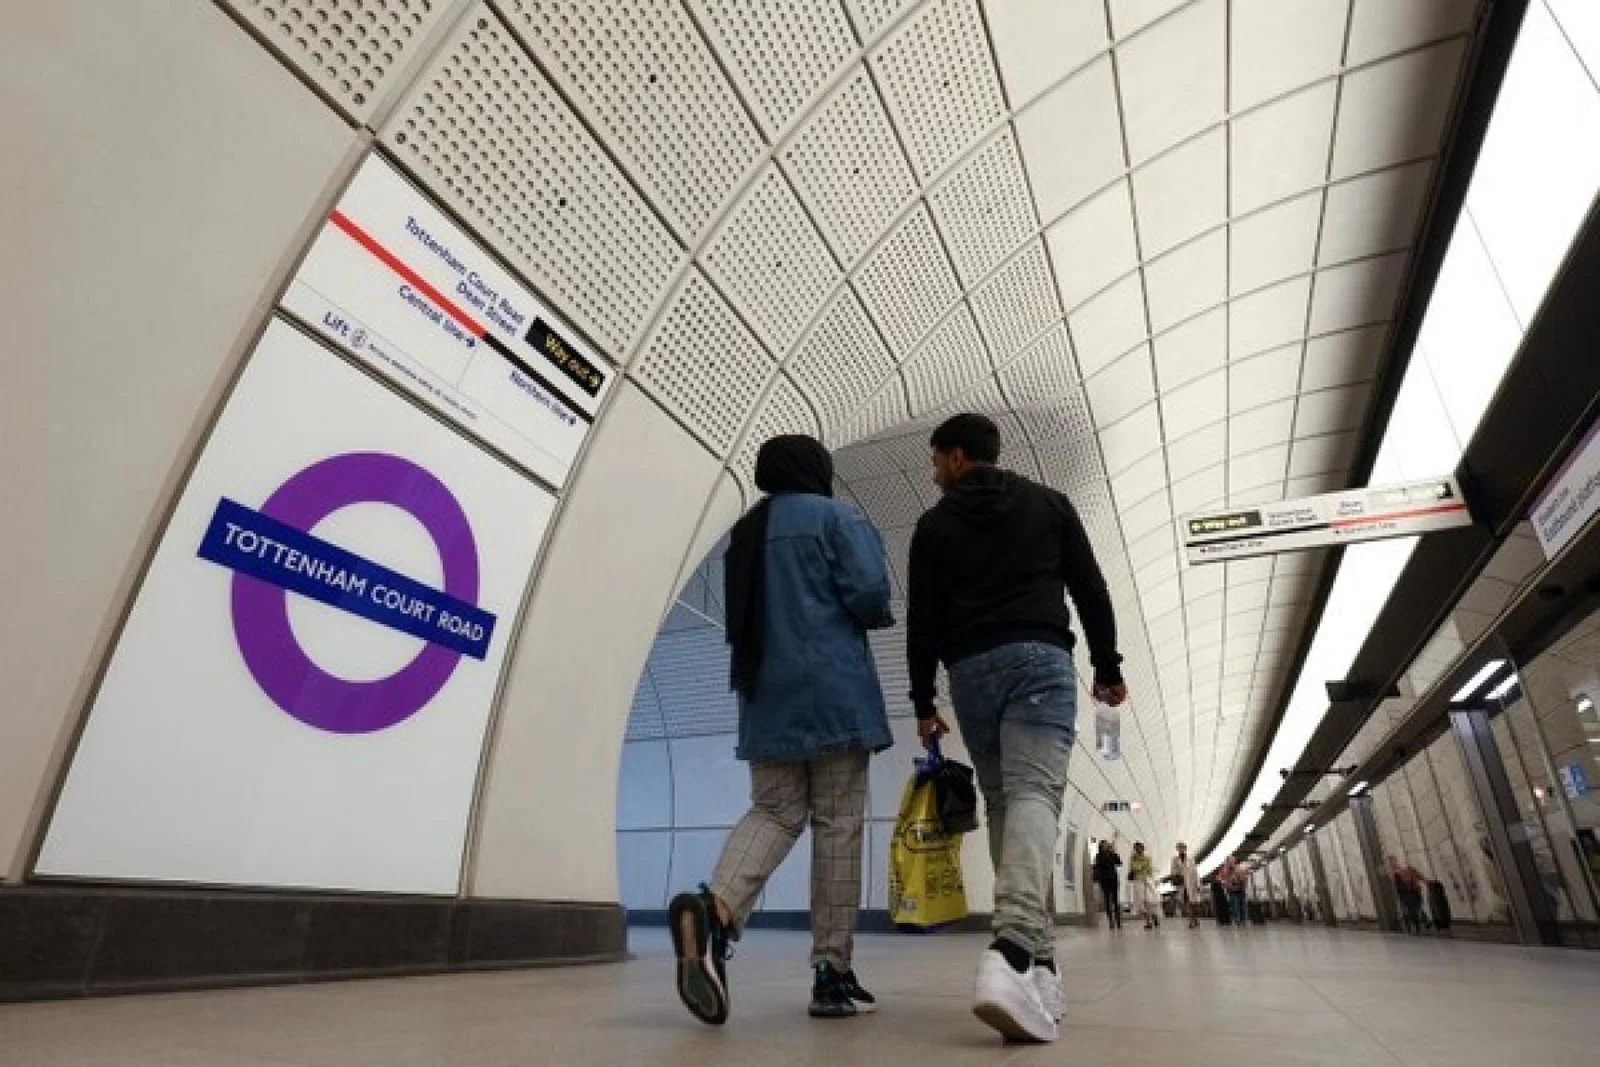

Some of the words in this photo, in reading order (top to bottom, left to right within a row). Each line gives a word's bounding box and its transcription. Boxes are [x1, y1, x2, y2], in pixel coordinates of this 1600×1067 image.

[323, 311, 350, 337] Lift
[222, 522, 368, 597] TOTTENHAM
[370, 584, 436, 623] COURT
[436, 610, 485, 642] ROAD
